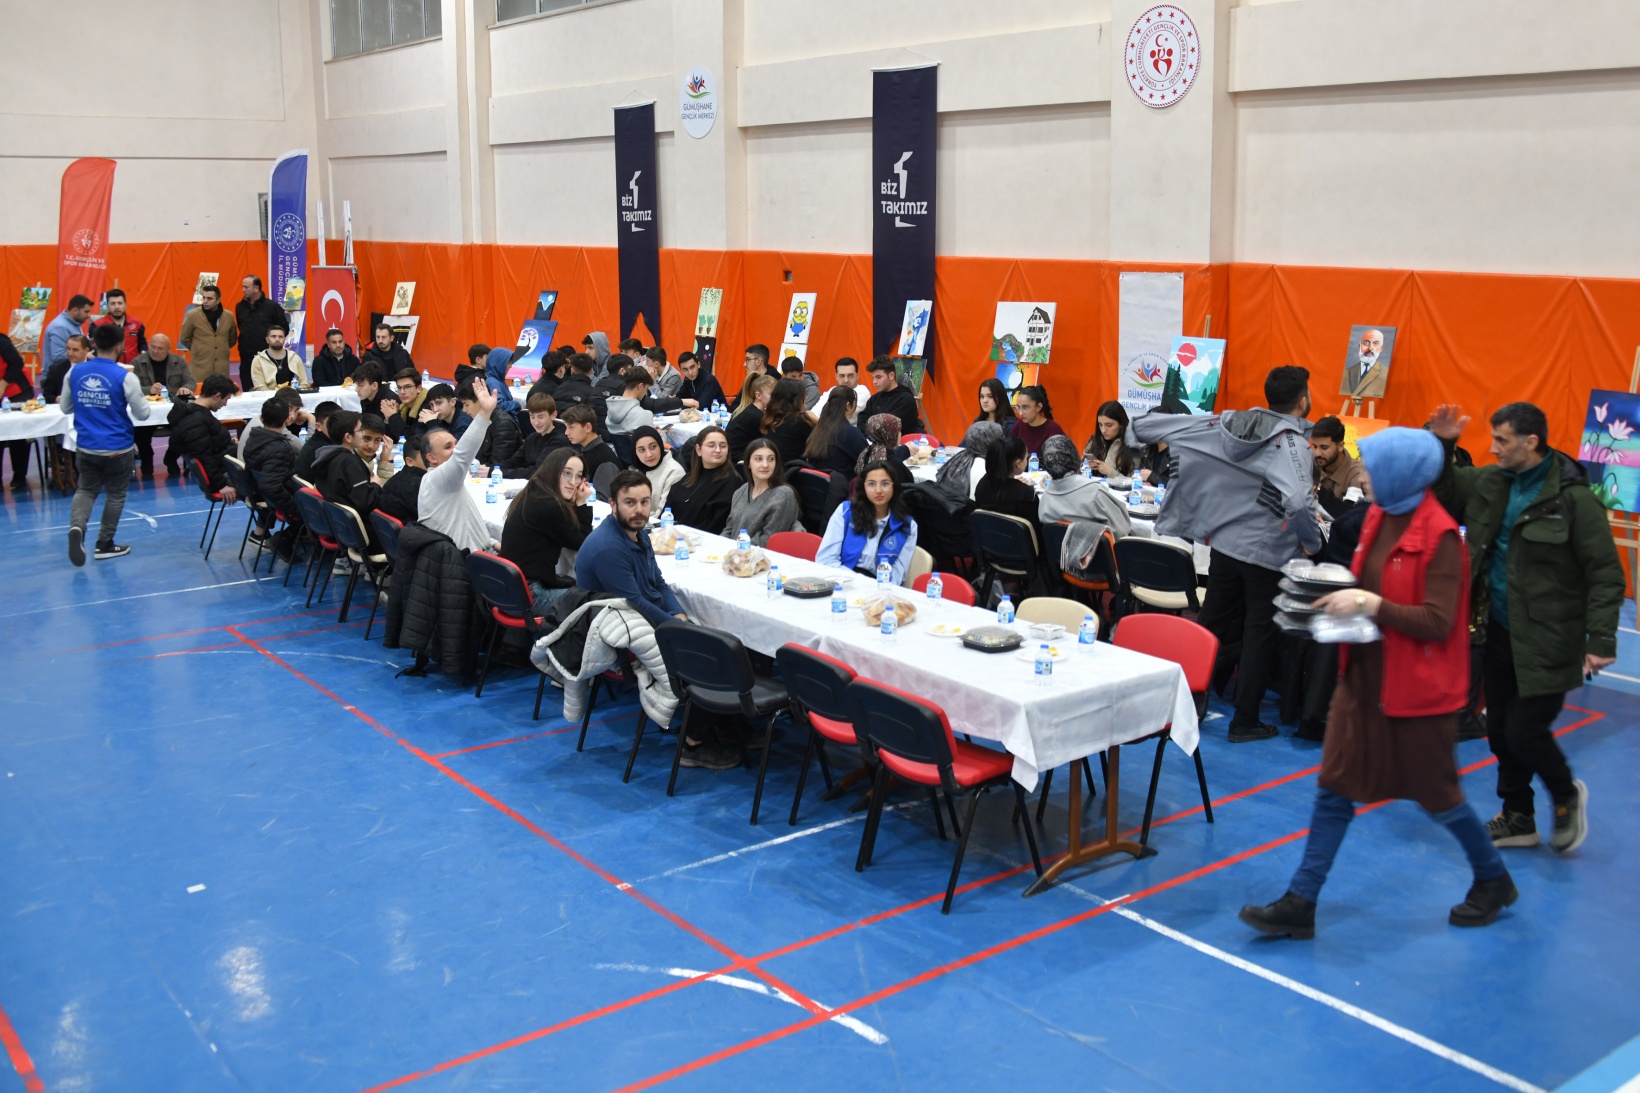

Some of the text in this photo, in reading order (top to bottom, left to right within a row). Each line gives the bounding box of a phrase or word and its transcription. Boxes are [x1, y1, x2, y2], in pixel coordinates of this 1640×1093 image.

[1174, 28, 1180, 36] VE
[683, 102, 712, 112] GÜMÜŞHANE
[1128, 388, 1163, 401] GÜMÜŞHA
